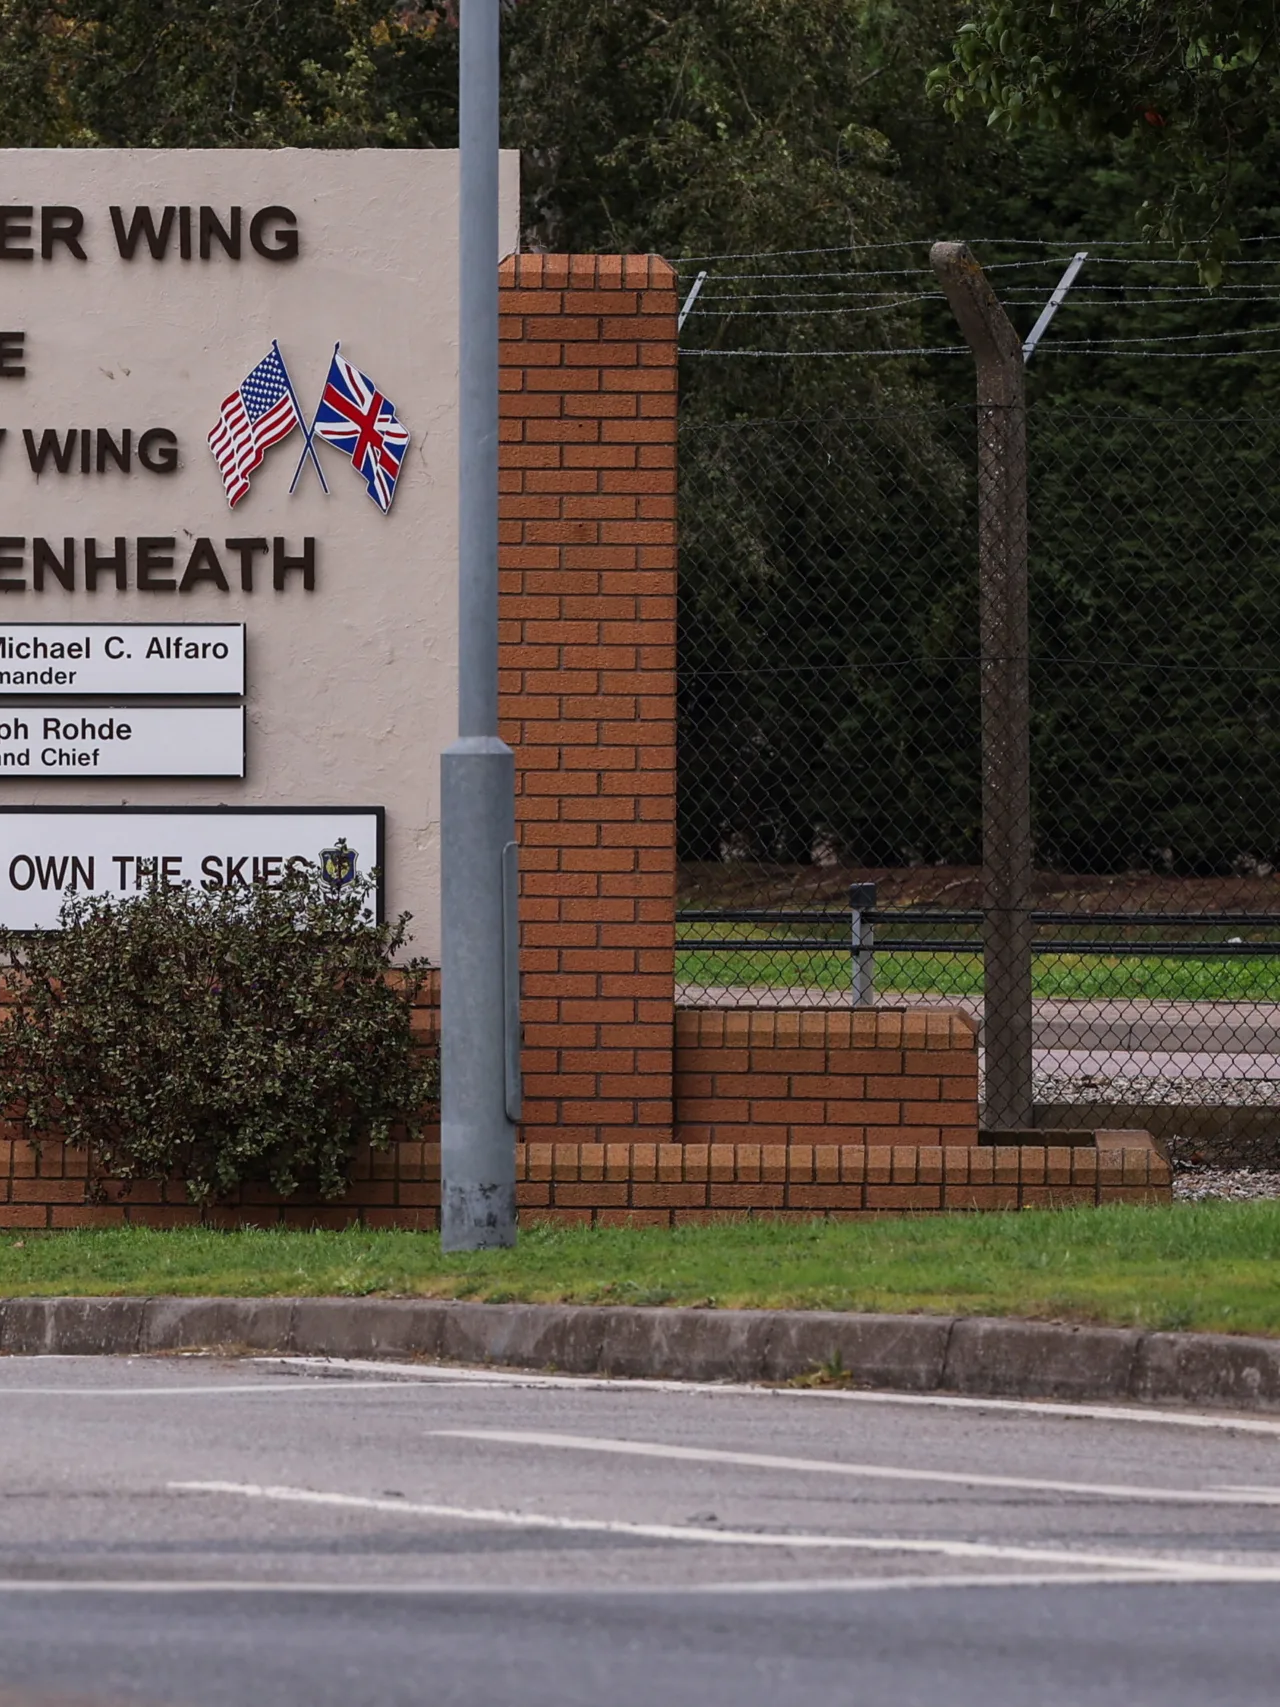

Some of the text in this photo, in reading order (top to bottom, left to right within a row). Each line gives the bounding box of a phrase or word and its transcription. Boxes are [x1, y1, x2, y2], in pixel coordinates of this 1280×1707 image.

[108, 205, 300, 265] WING
[22, 427, 179, 480] WING
[104, 636, 132, 660] C.
[145, 636, 230, 660] Alfaro
[43, 717, 133, 741] Rohde
[40, 747, 101, 768] Chief
[8, 854, 95, 891] OWN
[112, 855, 183, 891] THE
